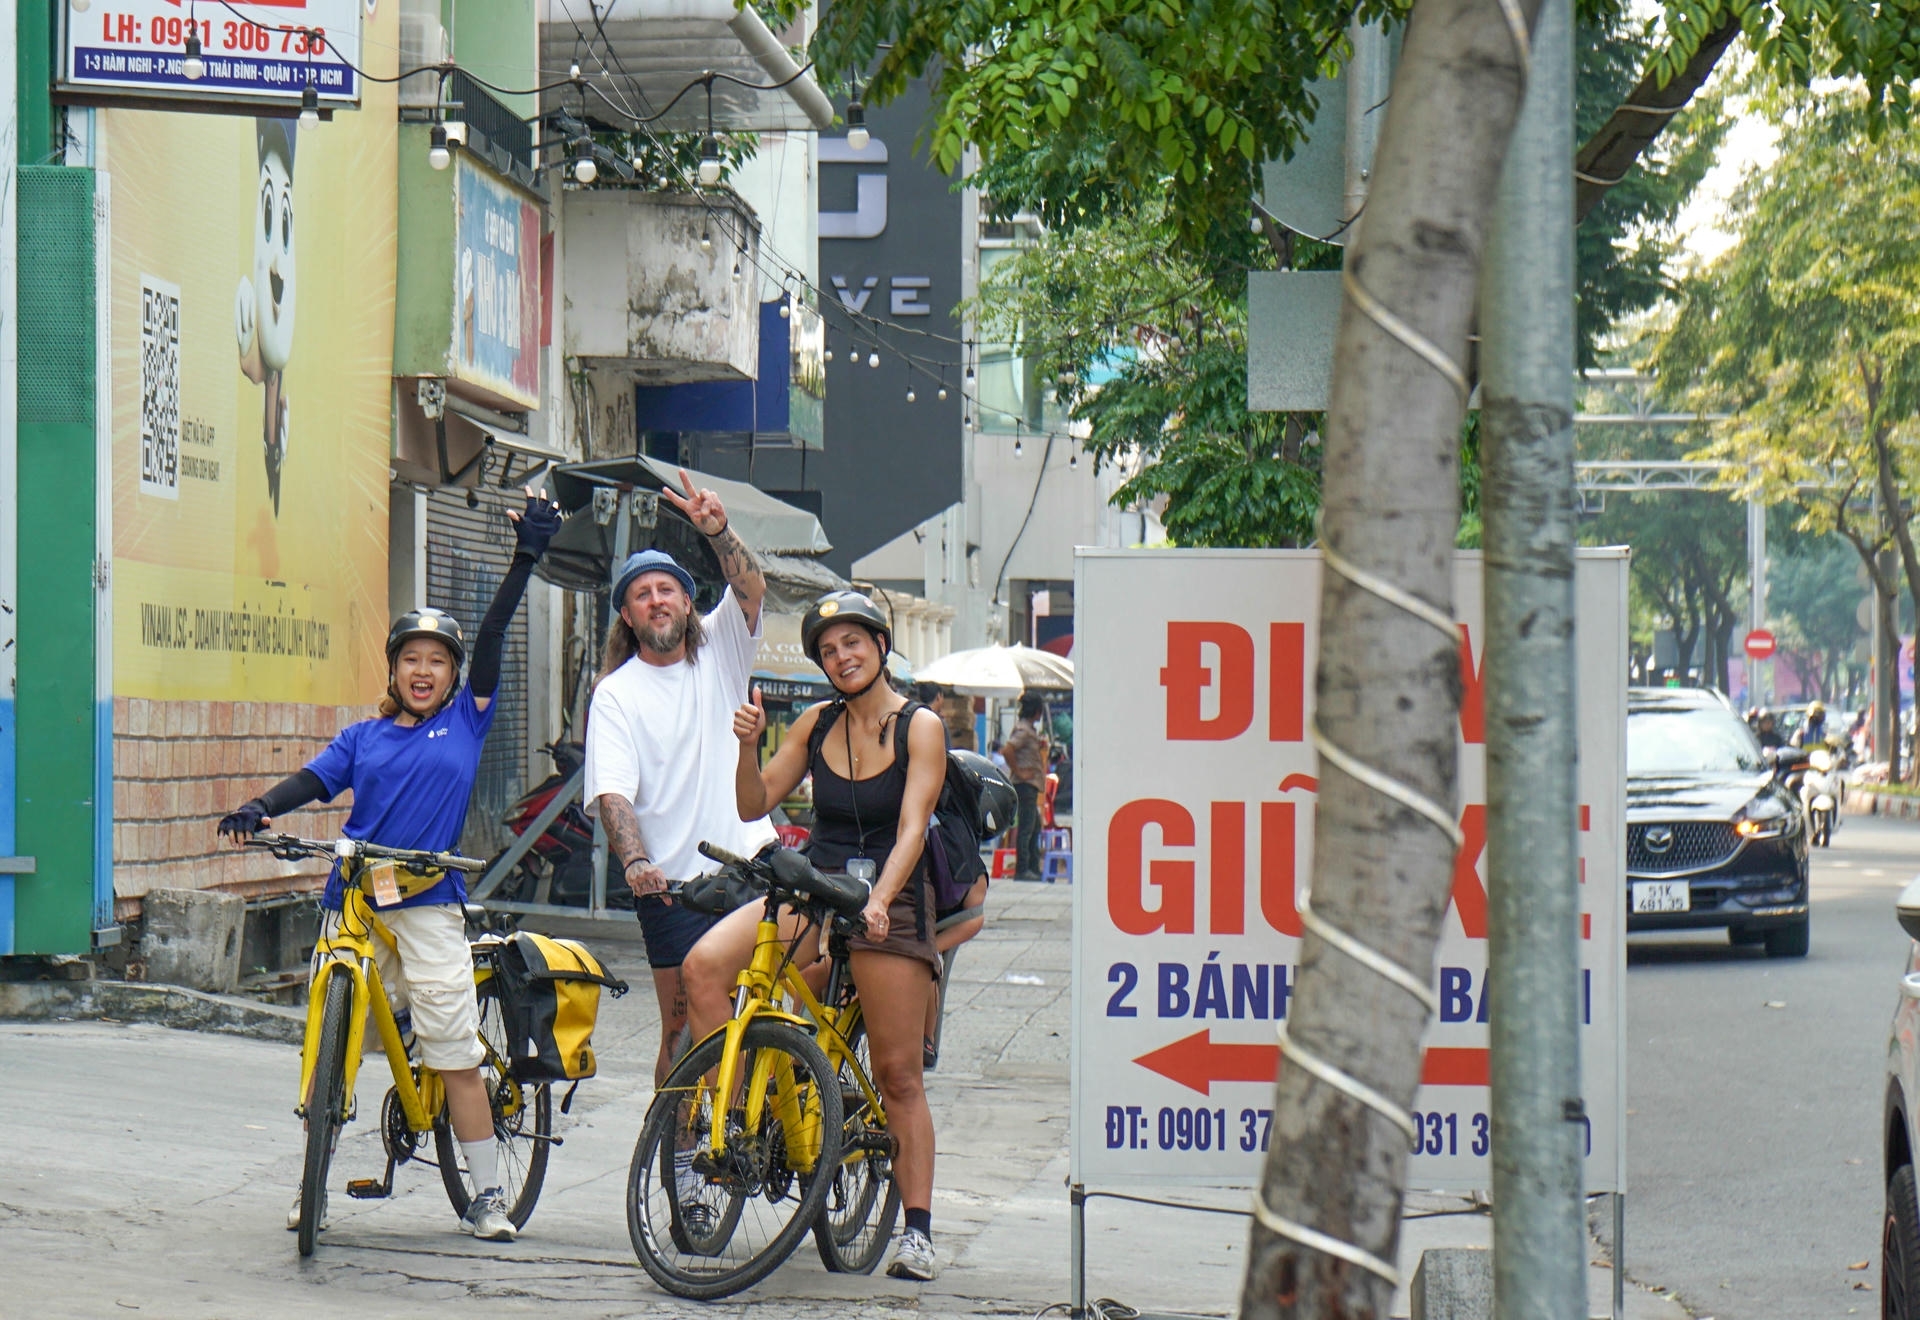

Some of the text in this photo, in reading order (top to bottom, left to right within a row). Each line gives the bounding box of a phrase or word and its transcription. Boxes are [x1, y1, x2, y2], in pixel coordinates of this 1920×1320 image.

[103, 13, 326, 56] LH: 0931 306 730
[103, 53, 125, 72] HÀM
[128, 56, 152, 74] NGHI
[158, 58, 207, 77] P.NGN
[210, 59, 231, 78] THÁI
[234, 62, 257, 81] BÌNH
[264, 63, 290, 86] QUẬN
[321, 69, 343, 86] HCM
[173, 607, 187, 649] JSC
[195, 608, 221, 651] DOANH
[222, 601, 251, 665] NGHIỆP
[253, 602, 270, 654] HÀNG
[753, 681, 812, 697] CHIN-SU
[1106, 961, 1139, 1018] 2
[1105, 1105, 1148, 1150] ĐT:
[1158, 1106, 1226, 1151] 0901
[1239, 1108, 1275, 1153] 37
